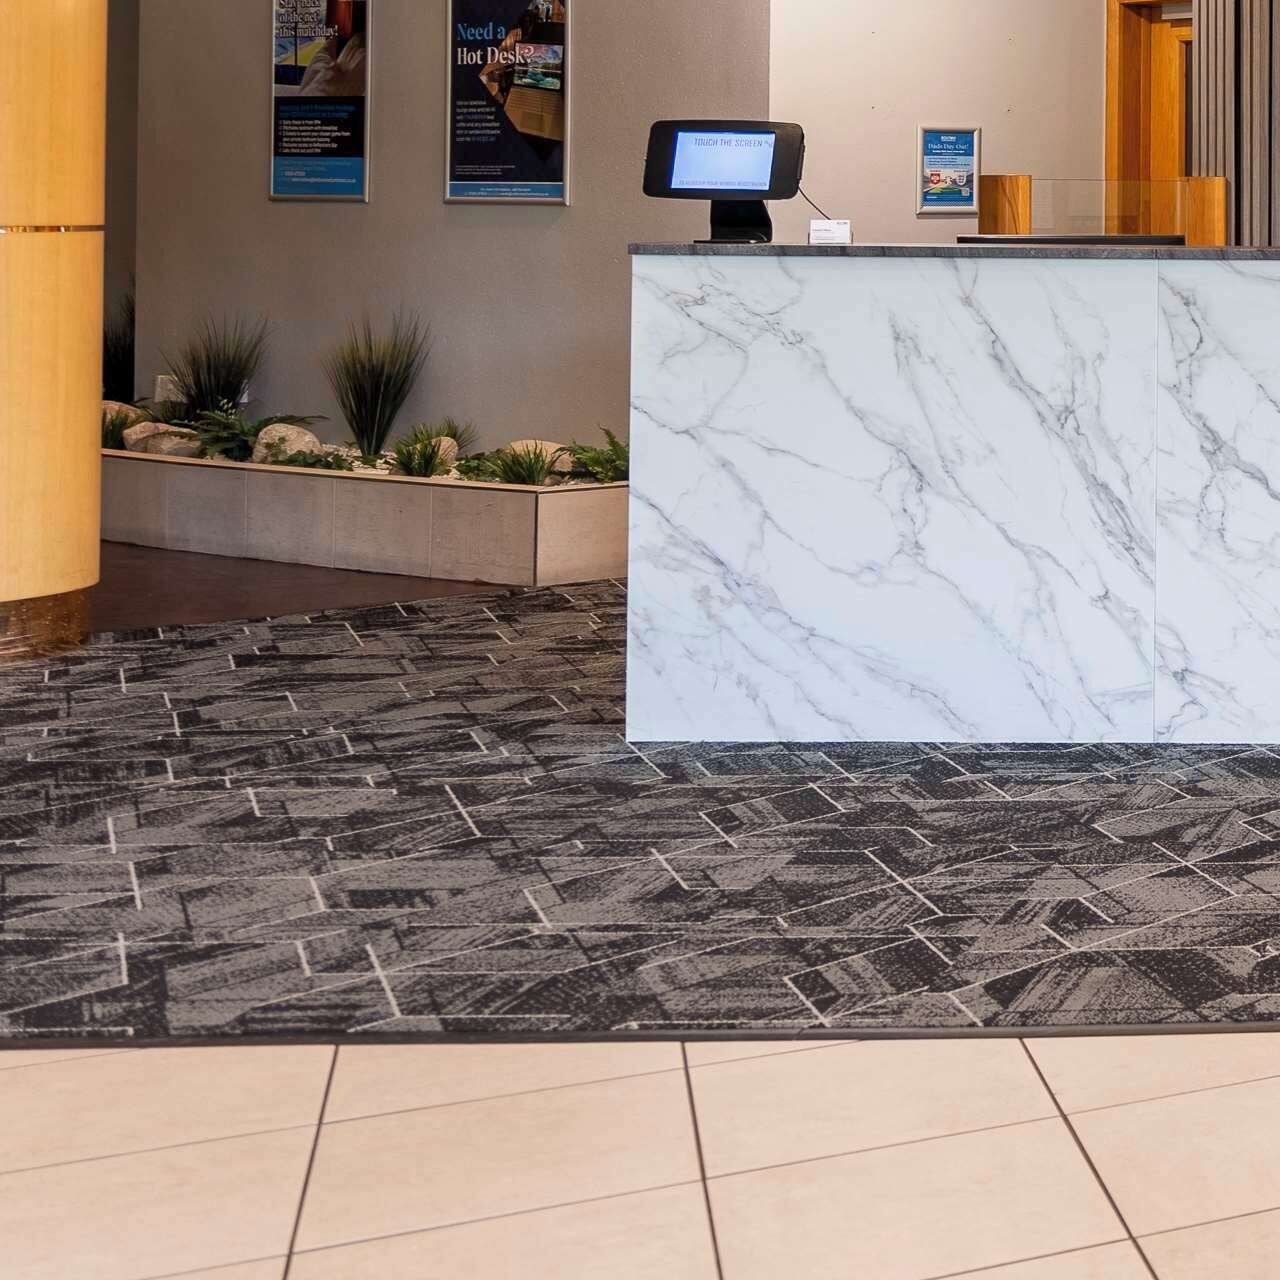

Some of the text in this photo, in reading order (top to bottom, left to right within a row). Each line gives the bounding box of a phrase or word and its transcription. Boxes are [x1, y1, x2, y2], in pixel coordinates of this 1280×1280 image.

[297, 24, 339, 40] matchday!
[457, 22, 506, 41] Need a
[457, 45, 534, 65] Hot Desk?
[694, 137, 763, 148] TOUCH THE SCREEN
